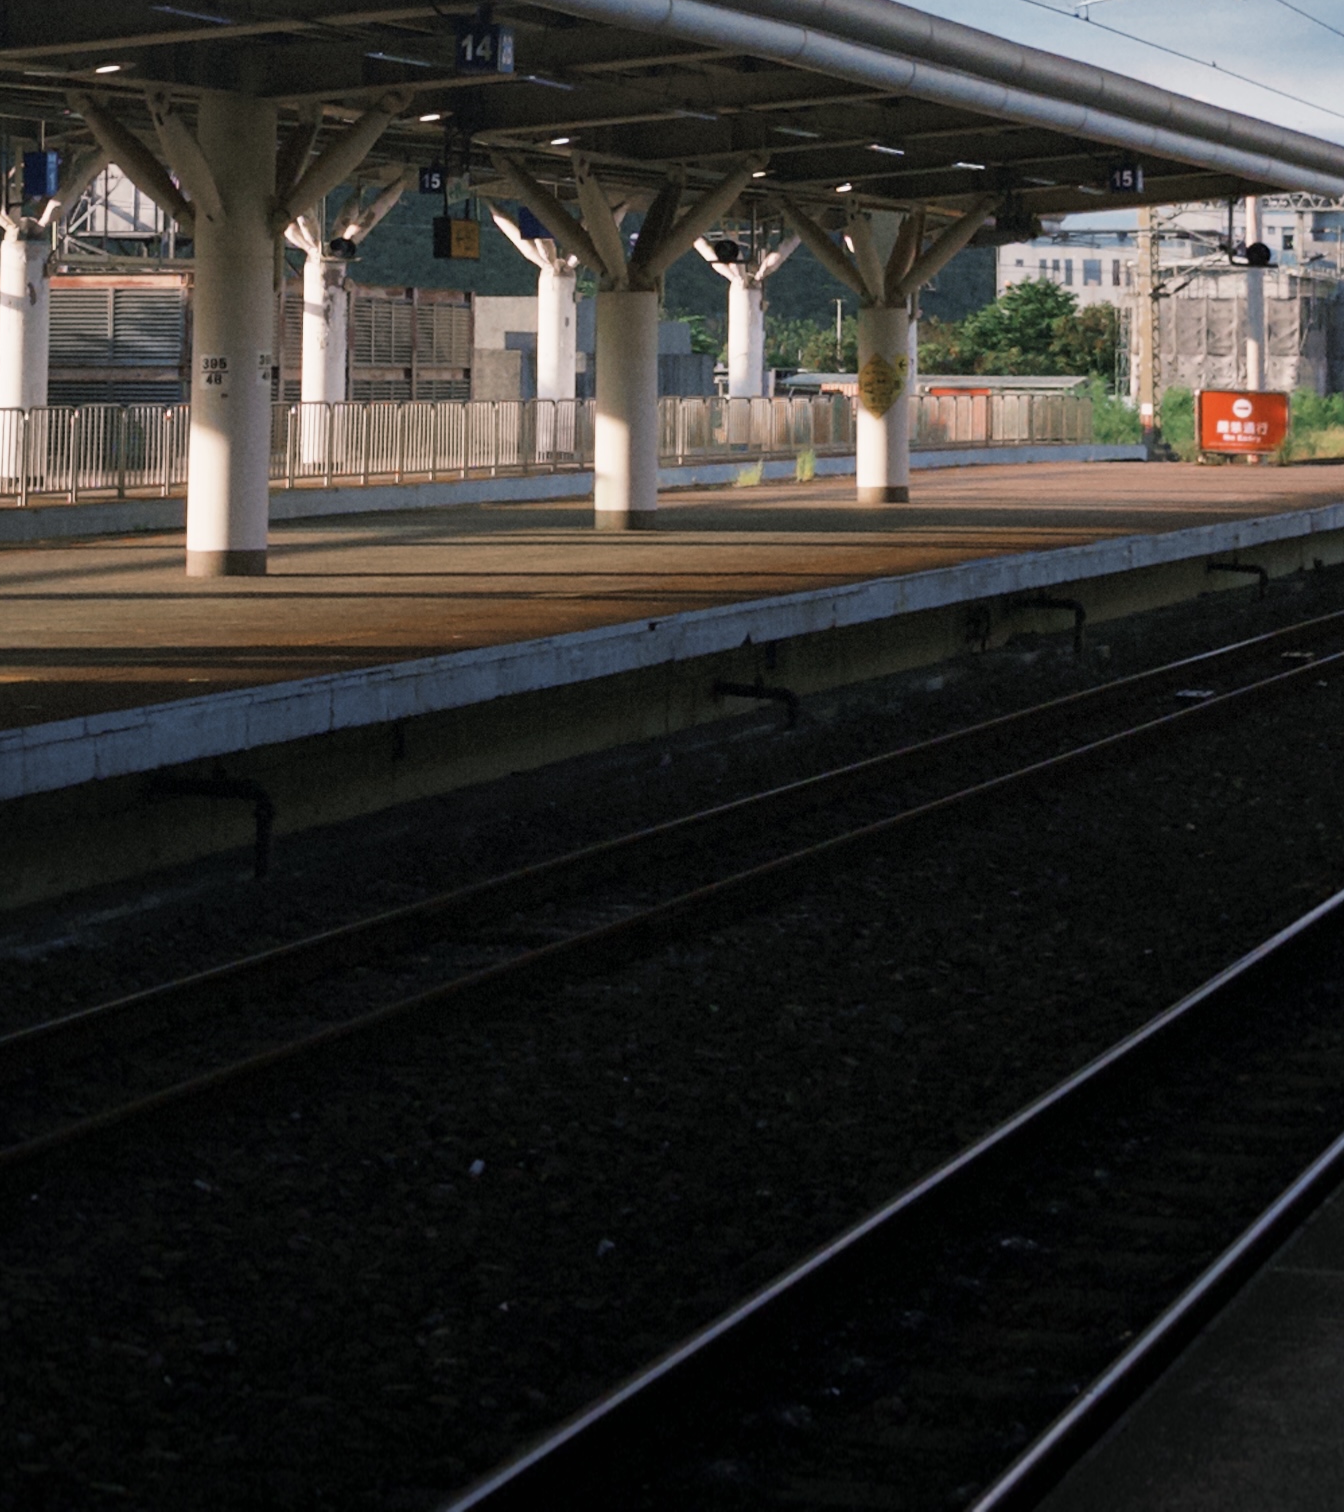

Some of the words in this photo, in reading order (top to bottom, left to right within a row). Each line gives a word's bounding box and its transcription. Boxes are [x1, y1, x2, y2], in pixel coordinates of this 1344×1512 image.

[461, 34, 493, 62] 14
[423, 172, 441, 189] 15
[1113, 169, 1133, 187] 15
